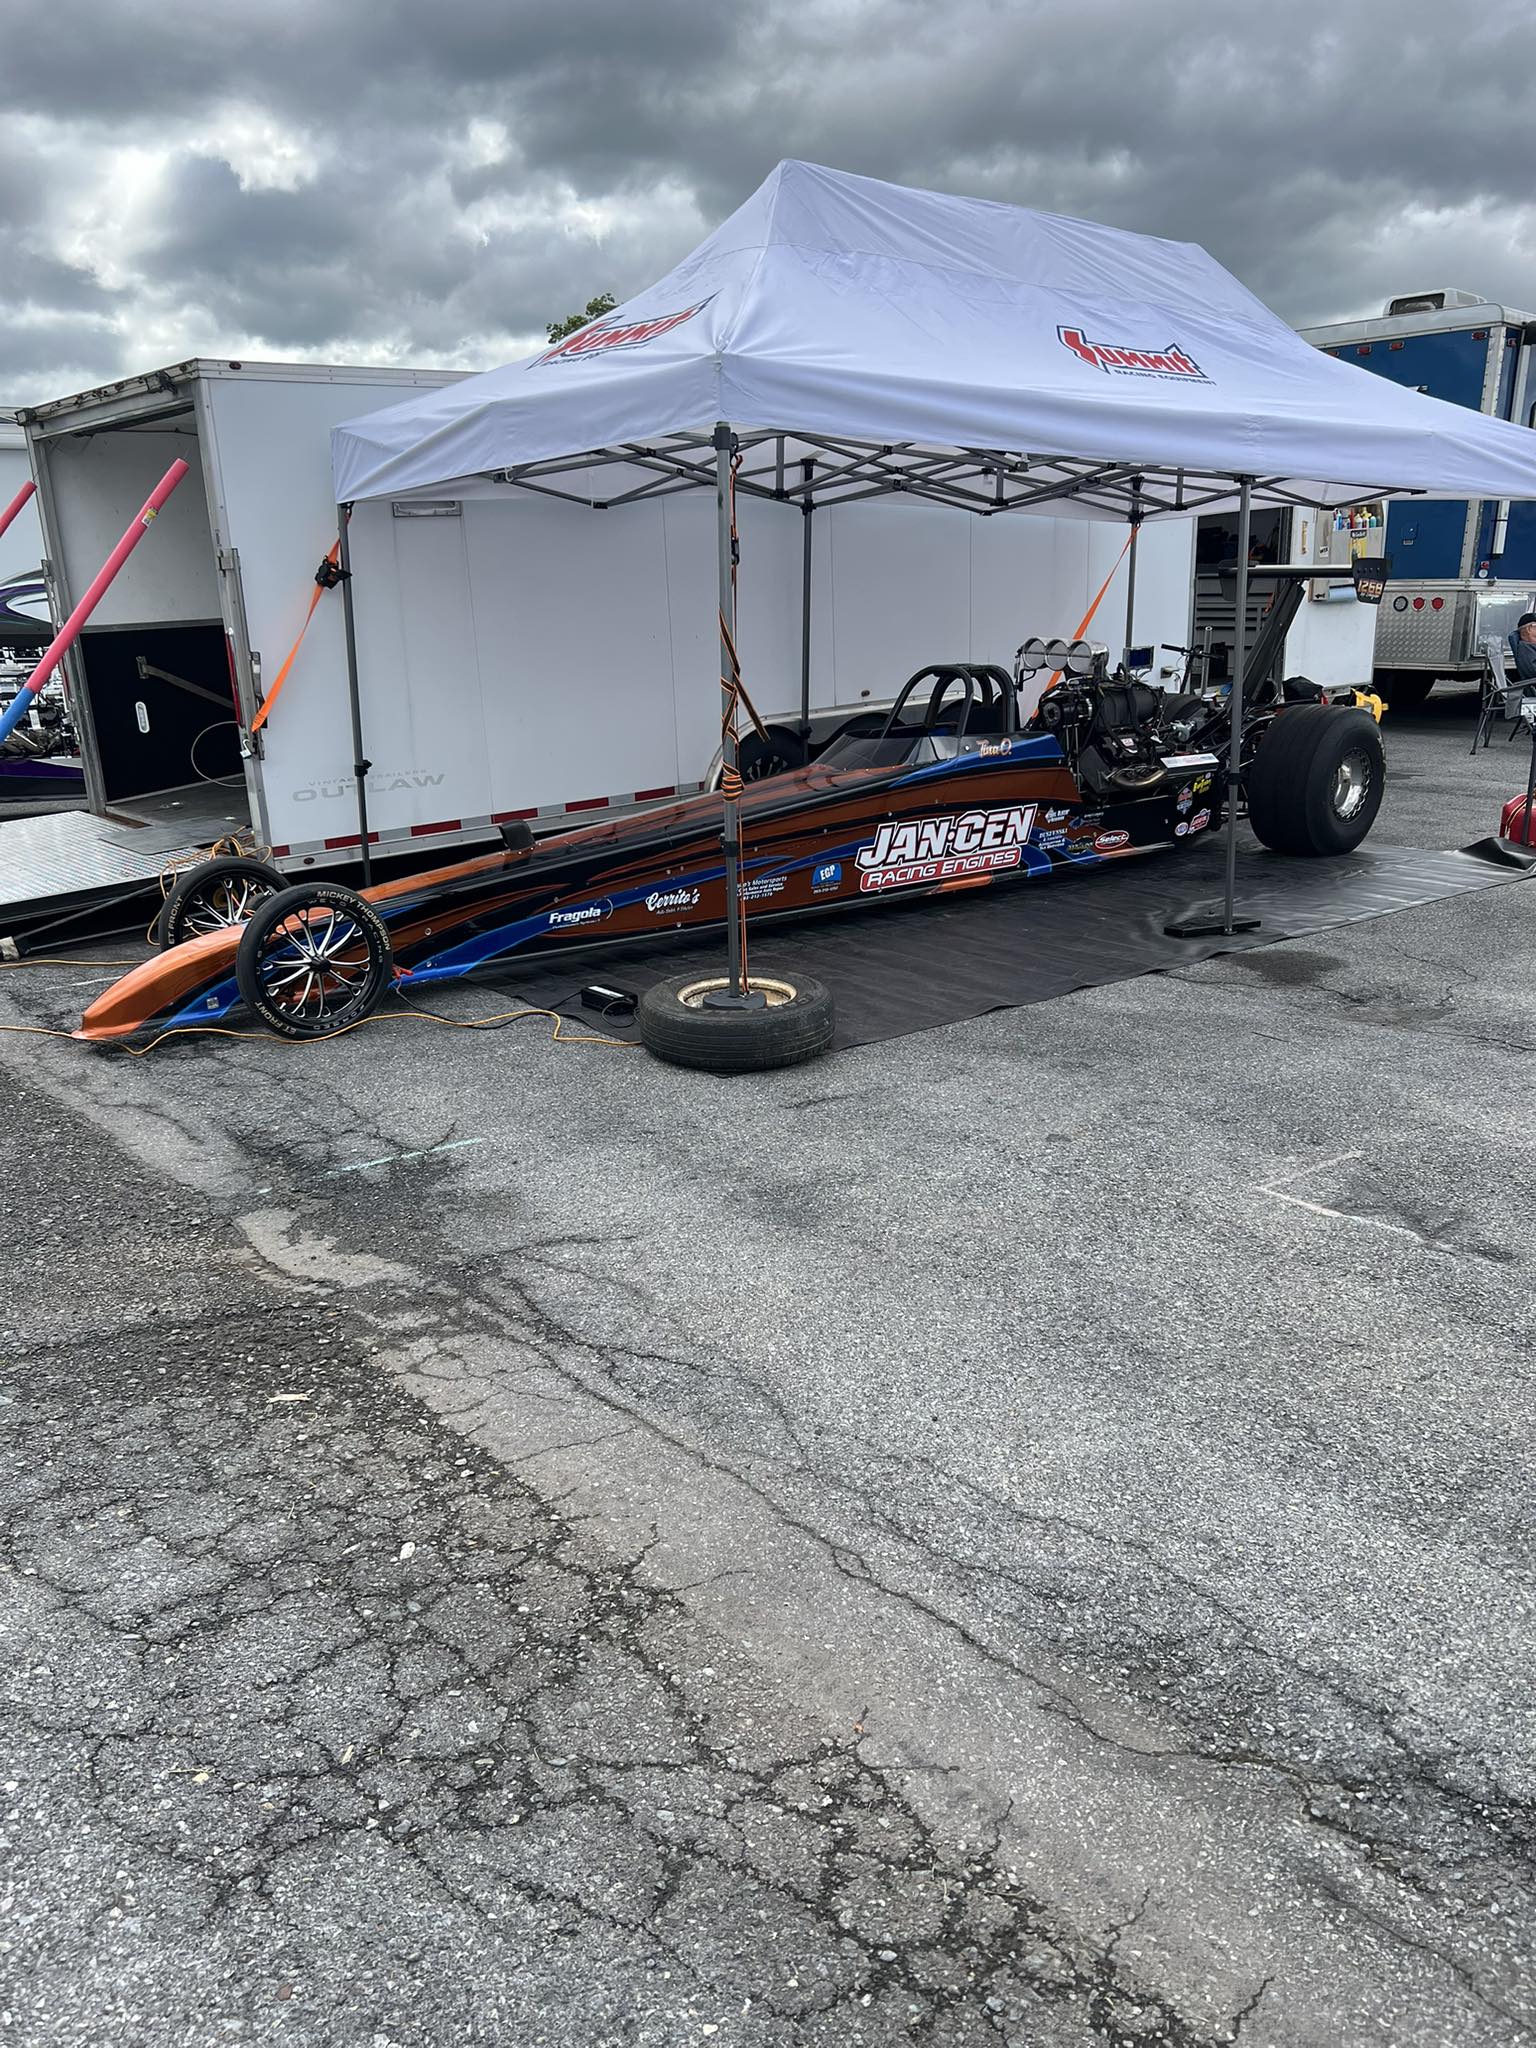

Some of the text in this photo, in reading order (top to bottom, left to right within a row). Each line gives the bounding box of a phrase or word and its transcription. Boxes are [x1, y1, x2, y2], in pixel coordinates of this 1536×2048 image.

[1061, 327, 1202, 376] SUMMIT
[1113, 369, 1217, 386] RACING EQUIPMENT
[976, 738, 1000, 758] Tina
[292, 773, 445, 802] OUTLAW
[1099, 833, 1127, 845] Select
[819, 864, 836, 881] EGP
[866, 848, 1018, 888] RACING ENGINES
[752, 876, 788, 887] Motorsports
[645, 888, 701, 912] Cerrito's
[167, 895, 184, 945] ET FRONT
[316, 890, 391, 951] MICKEY THOMPSON
[549, 906, 601, 924] Fragola
[254, 1001, 298, 1036] ET FRONT
